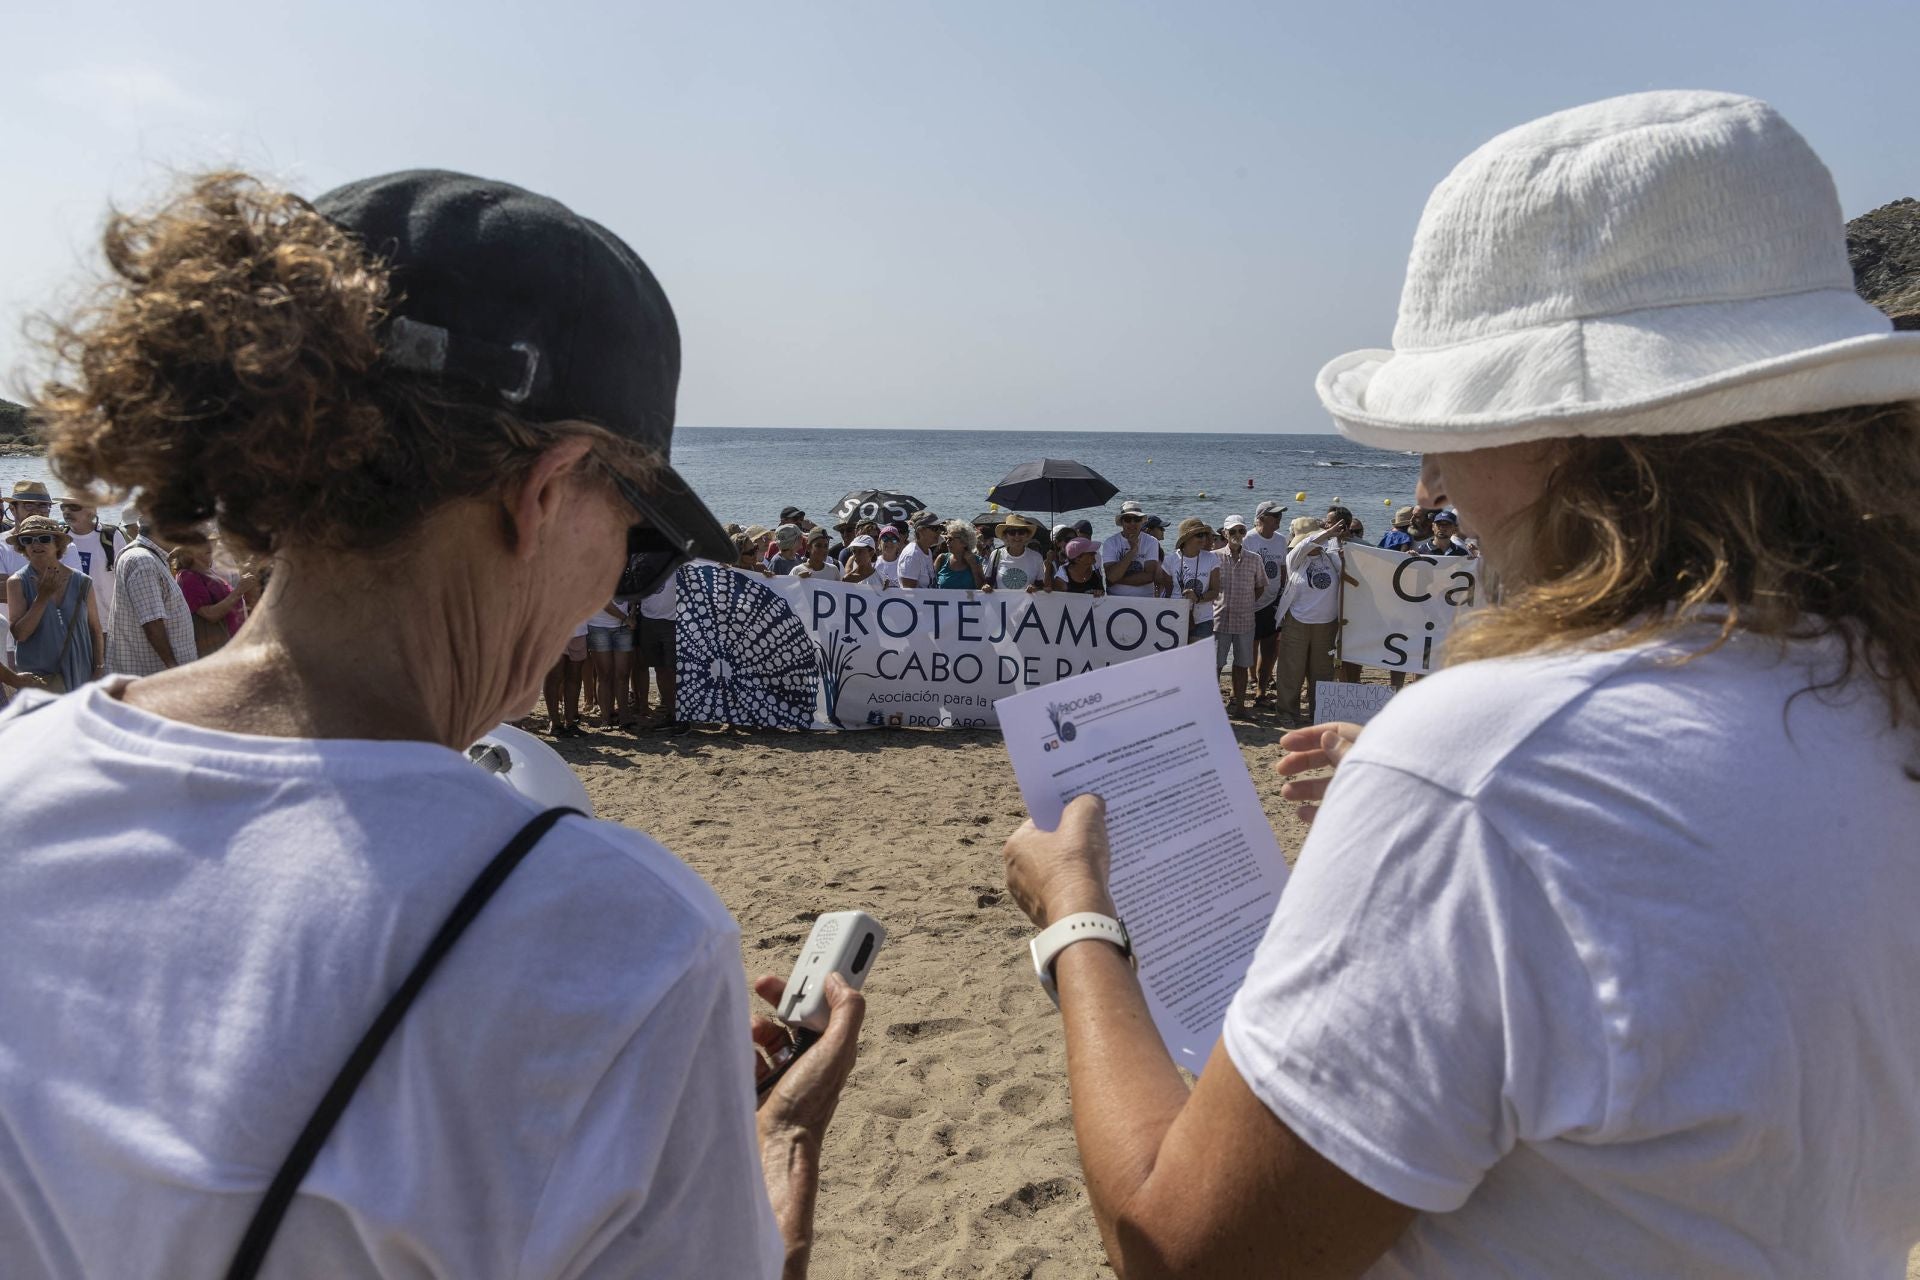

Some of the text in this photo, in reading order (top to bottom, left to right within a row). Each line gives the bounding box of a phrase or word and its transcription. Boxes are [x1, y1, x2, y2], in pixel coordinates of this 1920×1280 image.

[1392, 556, 1476, 607] Ca
[812, 589, 1180, 652] PROTEJAMOS
[876, 649, 983, 684] CABO
[998, 655, 1041, 686] DE
[866, 690, 940, 704] Asociación
[943, 693, 973, 706] para
[976, 694, 987, 708] la
